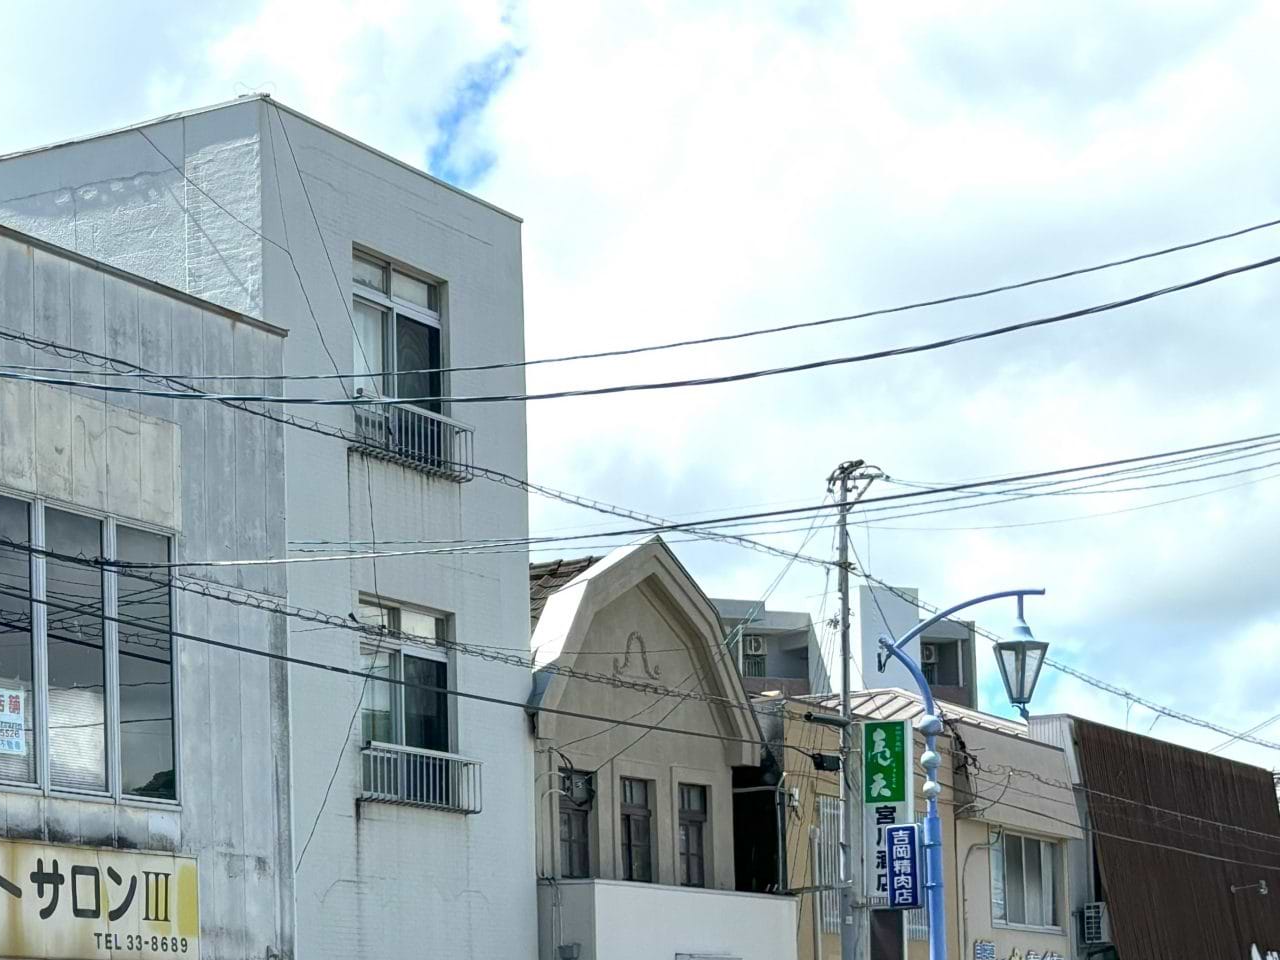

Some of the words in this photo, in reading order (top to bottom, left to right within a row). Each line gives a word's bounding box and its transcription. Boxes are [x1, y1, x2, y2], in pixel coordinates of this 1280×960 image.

[892, 830, 913, 904] 吉岡精肉店
[93, 932, 122, 951] TEL
[126, 934, 188, 953] 33-8689
